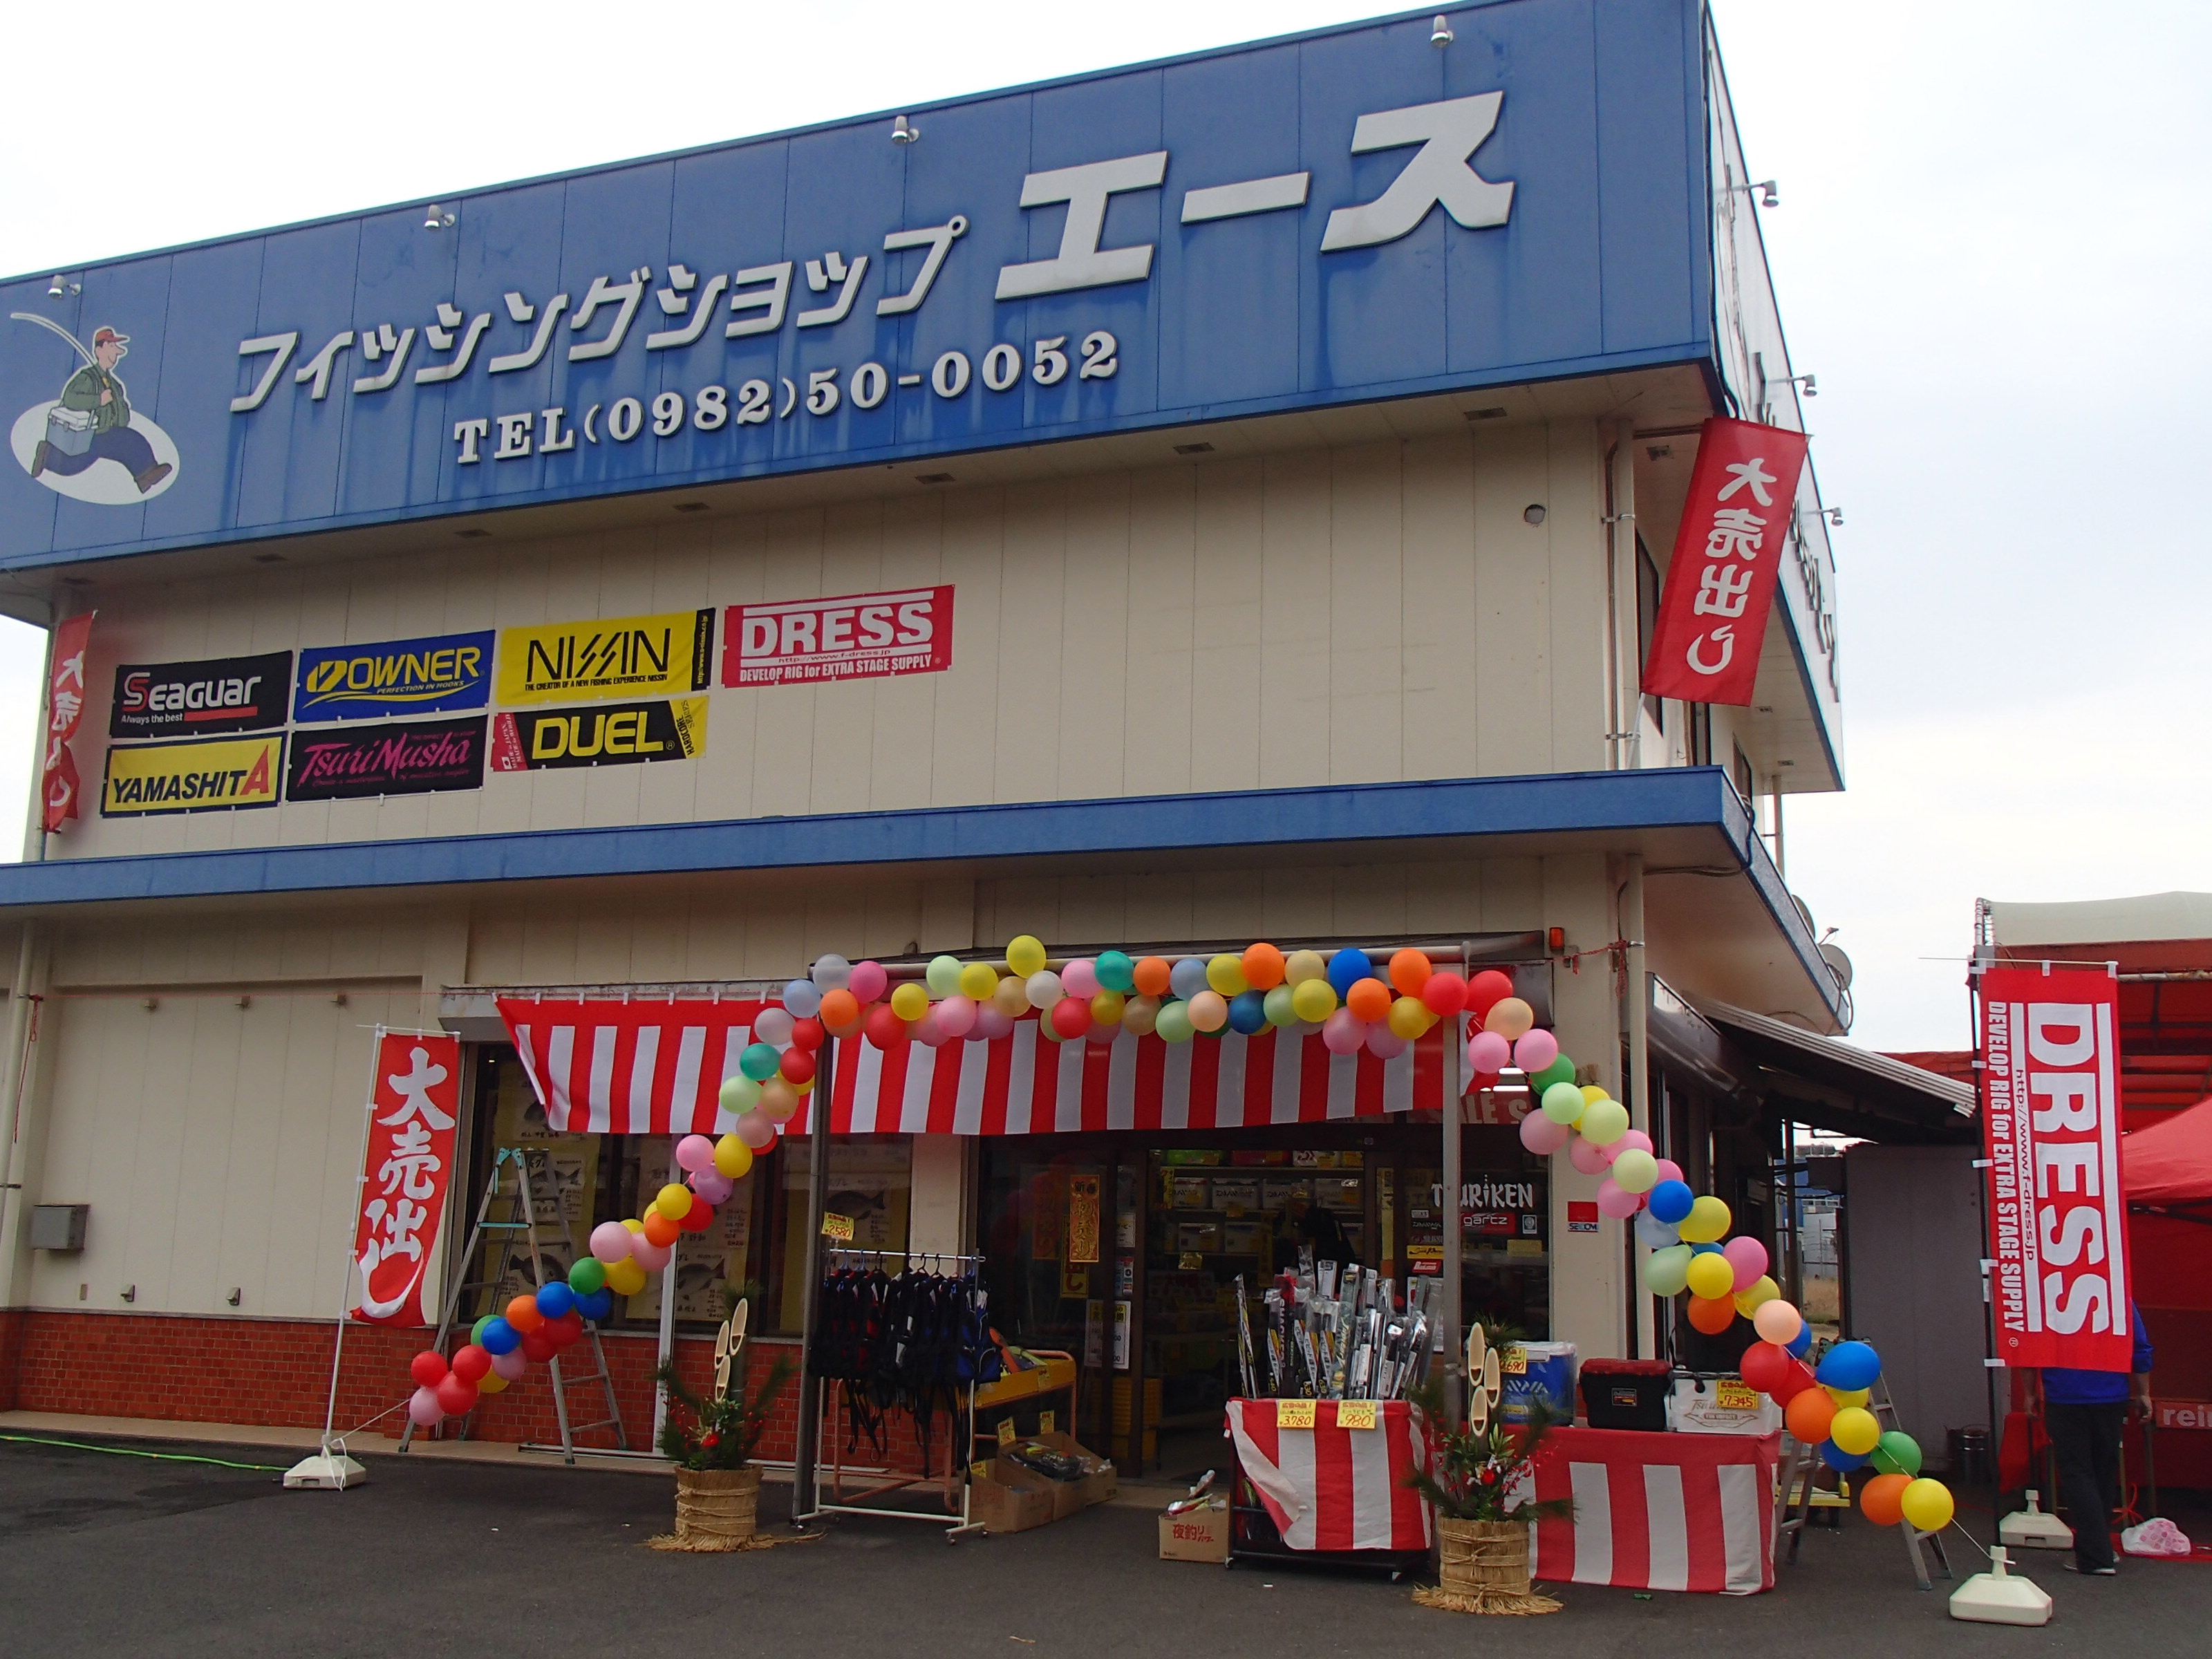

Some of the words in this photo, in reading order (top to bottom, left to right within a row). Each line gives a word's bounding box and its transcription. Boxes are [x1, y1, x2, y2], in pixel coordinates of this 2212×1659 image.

[230, 215, 967, 413] フィッシングショップ
[995, 91, 1516, 301] エース
[741, 601, 933, 657] DRESS
[347, 646, 480, 691] OWNER
[526, 628, 671, 682] NISSIN
[740, 668, 782, 682] DEVELOP
[785, 666, 803, 679] RIG
[805, 665, 821, 678] for
[822, 662, 854, 677] EXTRA
[856, 659, 889, 673] STAGE
[891, 654, 932, 671] SUPPLY
[123, 672, 262, 711] Seaguar
[377, 684, 424, 694] PERFECTION
[437, 679, 465, 689] HOOKS
[525, 683, 535, 691] THE
[536, 681, 561, 690] CREATOR
[590, 677, 612, 686] FISHING
[613, 675, 646, 684] EXPERIENCE
[648, 673, 668, 682] NISSIN
[121, 715, 149, 726] Always
[151, 714, 164, 723] the
[165, 713, 183, 722] best
[532, 711, 664, 760] DUEL
[675, 715, 695, 756] HARDCORE
[113, 744, 270, 803] YAMASHITA
[1988, 1001, 2009, 1077] DEVELOP
[1991, 1078, 2009, 1112] RIG
[1991, 1113, 2010, 1141] for
[359, 1046, 456, 1319] 大売出し
[1994, 1143, 2014, 1201] EXTRA
[2015, 1069, 2035, 1261] http://www.f-dress.jp
[2027, 1002, 2110, 1334] DRESS
[1463, 1216, 1508, 1227] gartz
[1996, 1203, 2019, 1262] STAGE
[2000, 1264, 2024, 1332] SUPPLY
